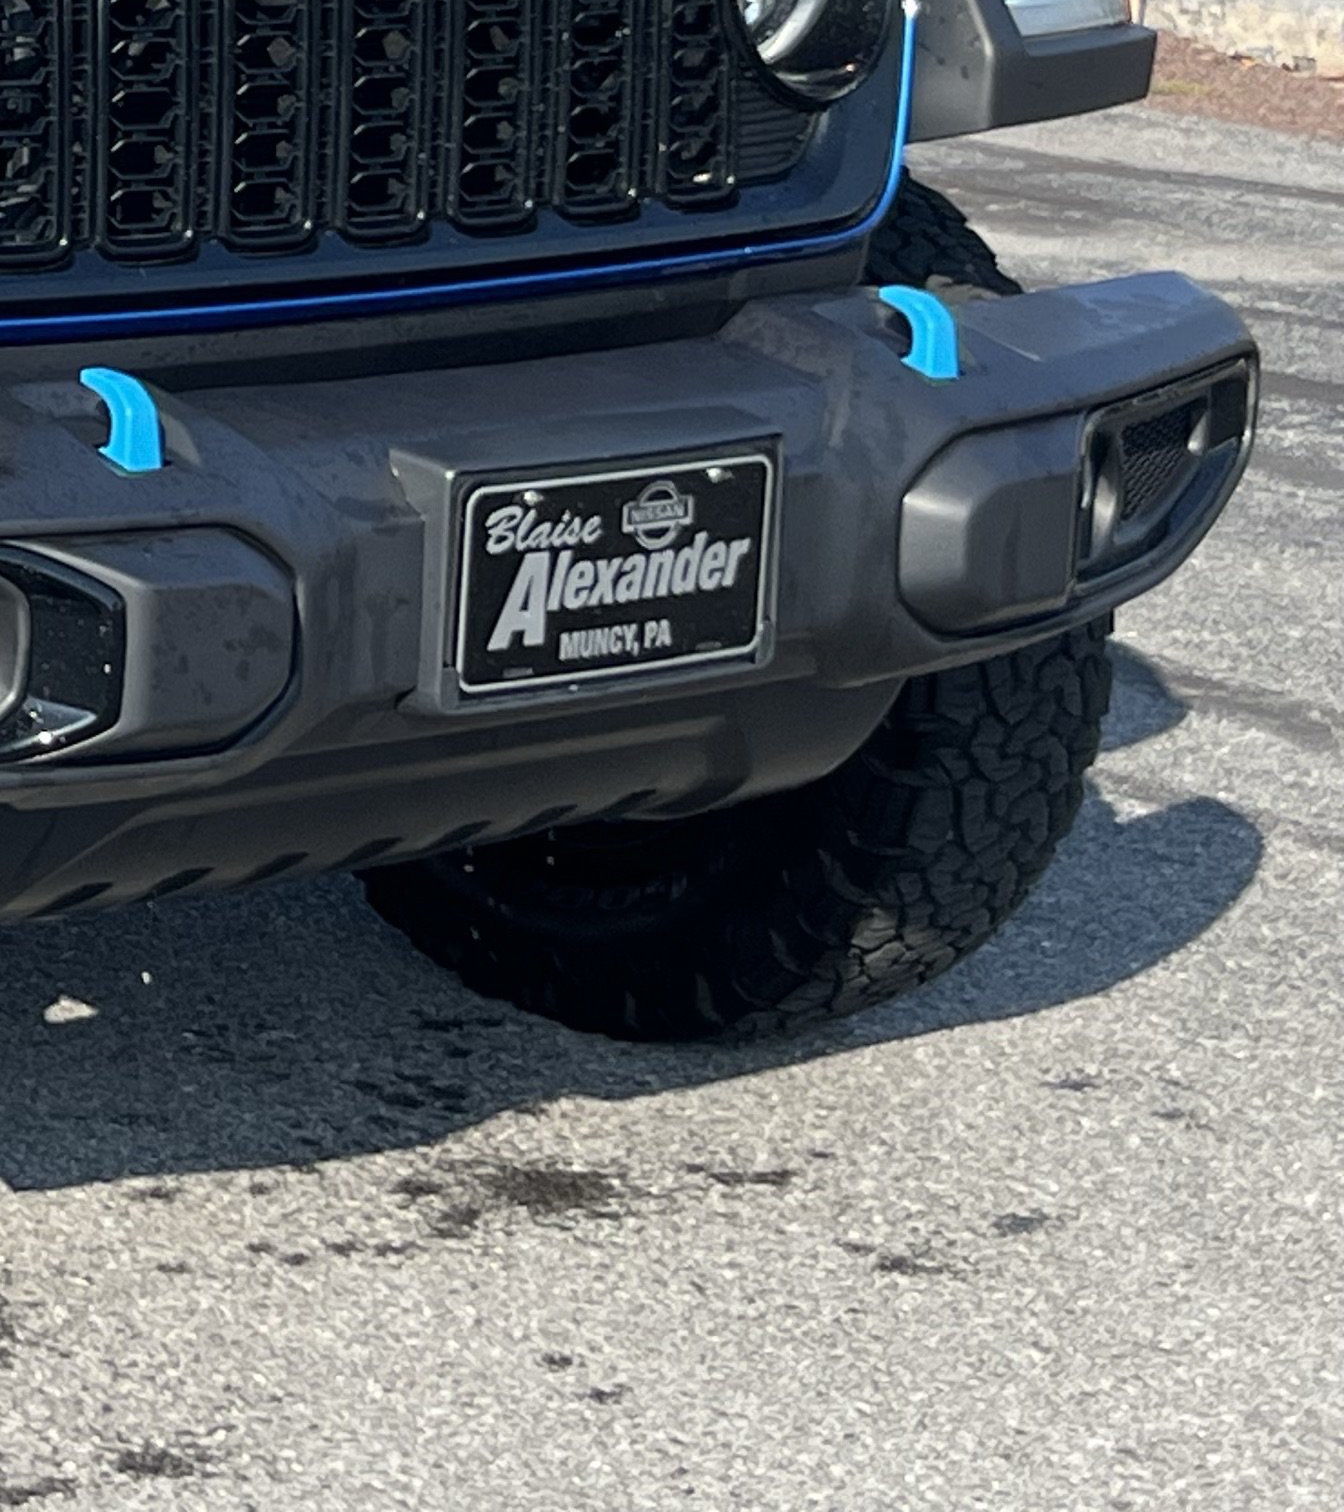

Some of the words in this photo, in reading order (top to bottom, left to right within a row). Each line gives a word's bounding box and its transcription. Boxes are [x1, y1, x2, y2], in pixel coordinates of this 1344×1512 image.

[484, 505, 602, 555] Blaise
[631, 503, 685, 525] NISSAN
[486, 531, 751, 651] Alexander
[559, 622, 639, 661] MUNCY,
[644, 618, 672, 649] PA
